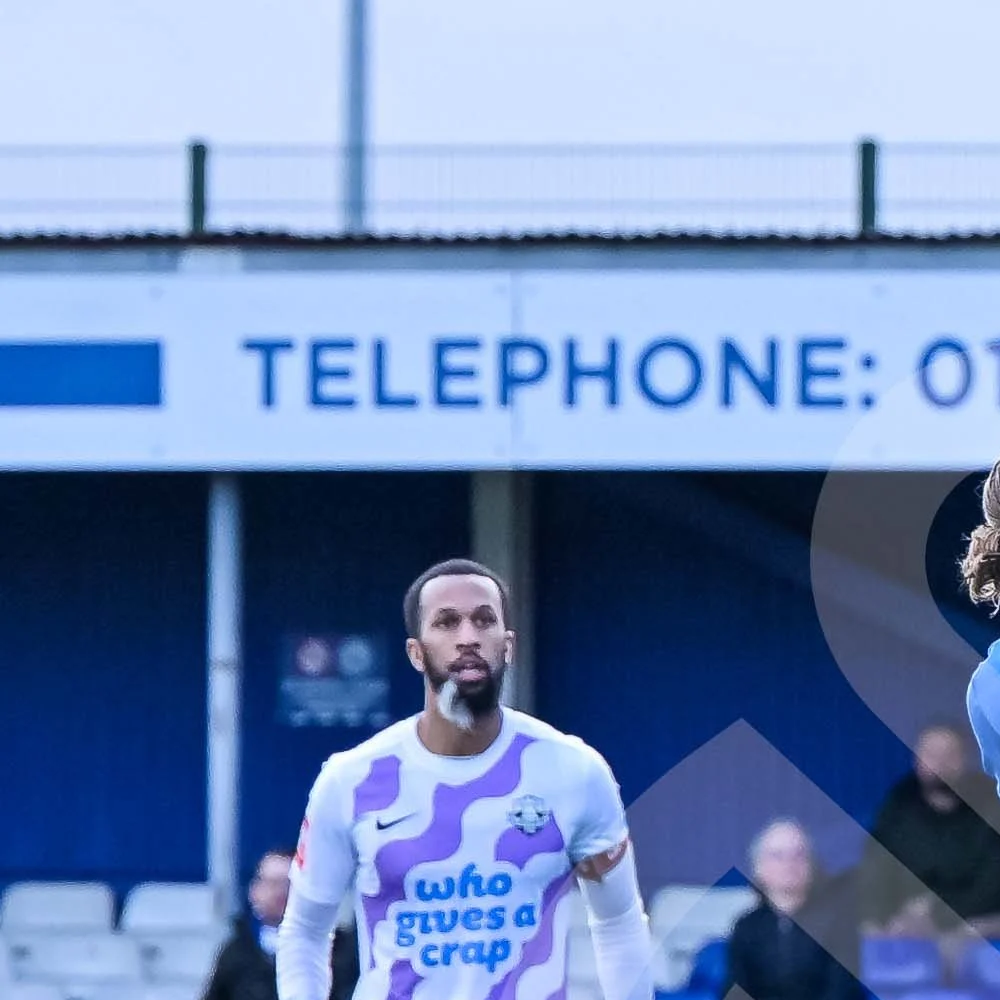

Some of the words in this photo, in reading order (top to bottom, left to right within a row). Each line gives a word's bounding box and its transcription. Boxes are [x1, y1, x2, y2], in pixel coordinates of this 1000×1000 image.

[243, 337, 875, 408] TELEPHONE:
[415, 862, 513, 901] who
[396, 905, 506, 947] gives
[513, 903, 537, 928] a
[420, 938, 513, 973] crap
